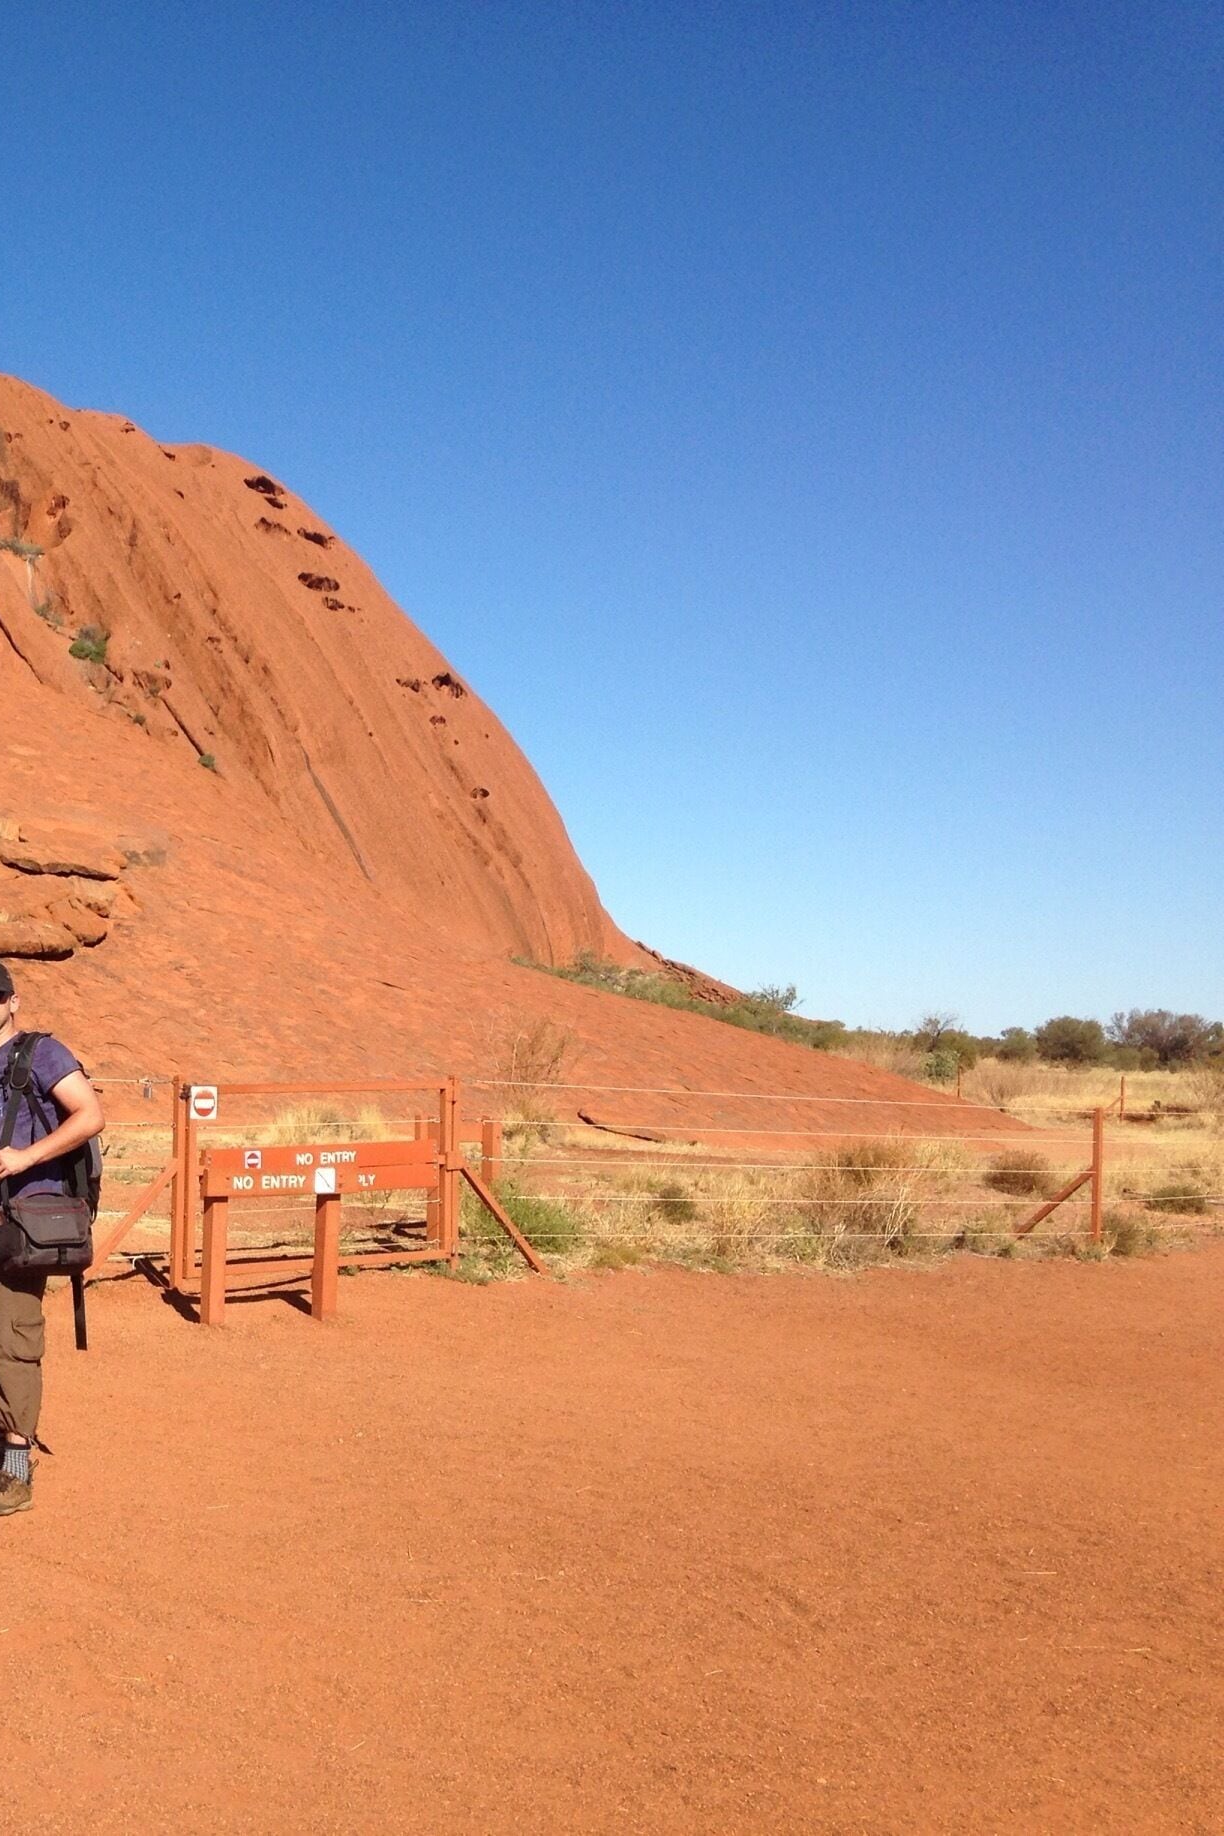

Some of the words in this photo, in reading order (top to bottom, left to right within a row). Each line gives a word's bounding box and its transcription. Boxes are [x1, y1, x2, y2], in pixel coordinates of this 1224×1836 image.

[296, 1152, 314, 1166] NO
[320, 1151, 357, 1165] ENTRY
[233, 1176, 254, 1190] NO
[262, 1175, 306, 1190] ENTRY
